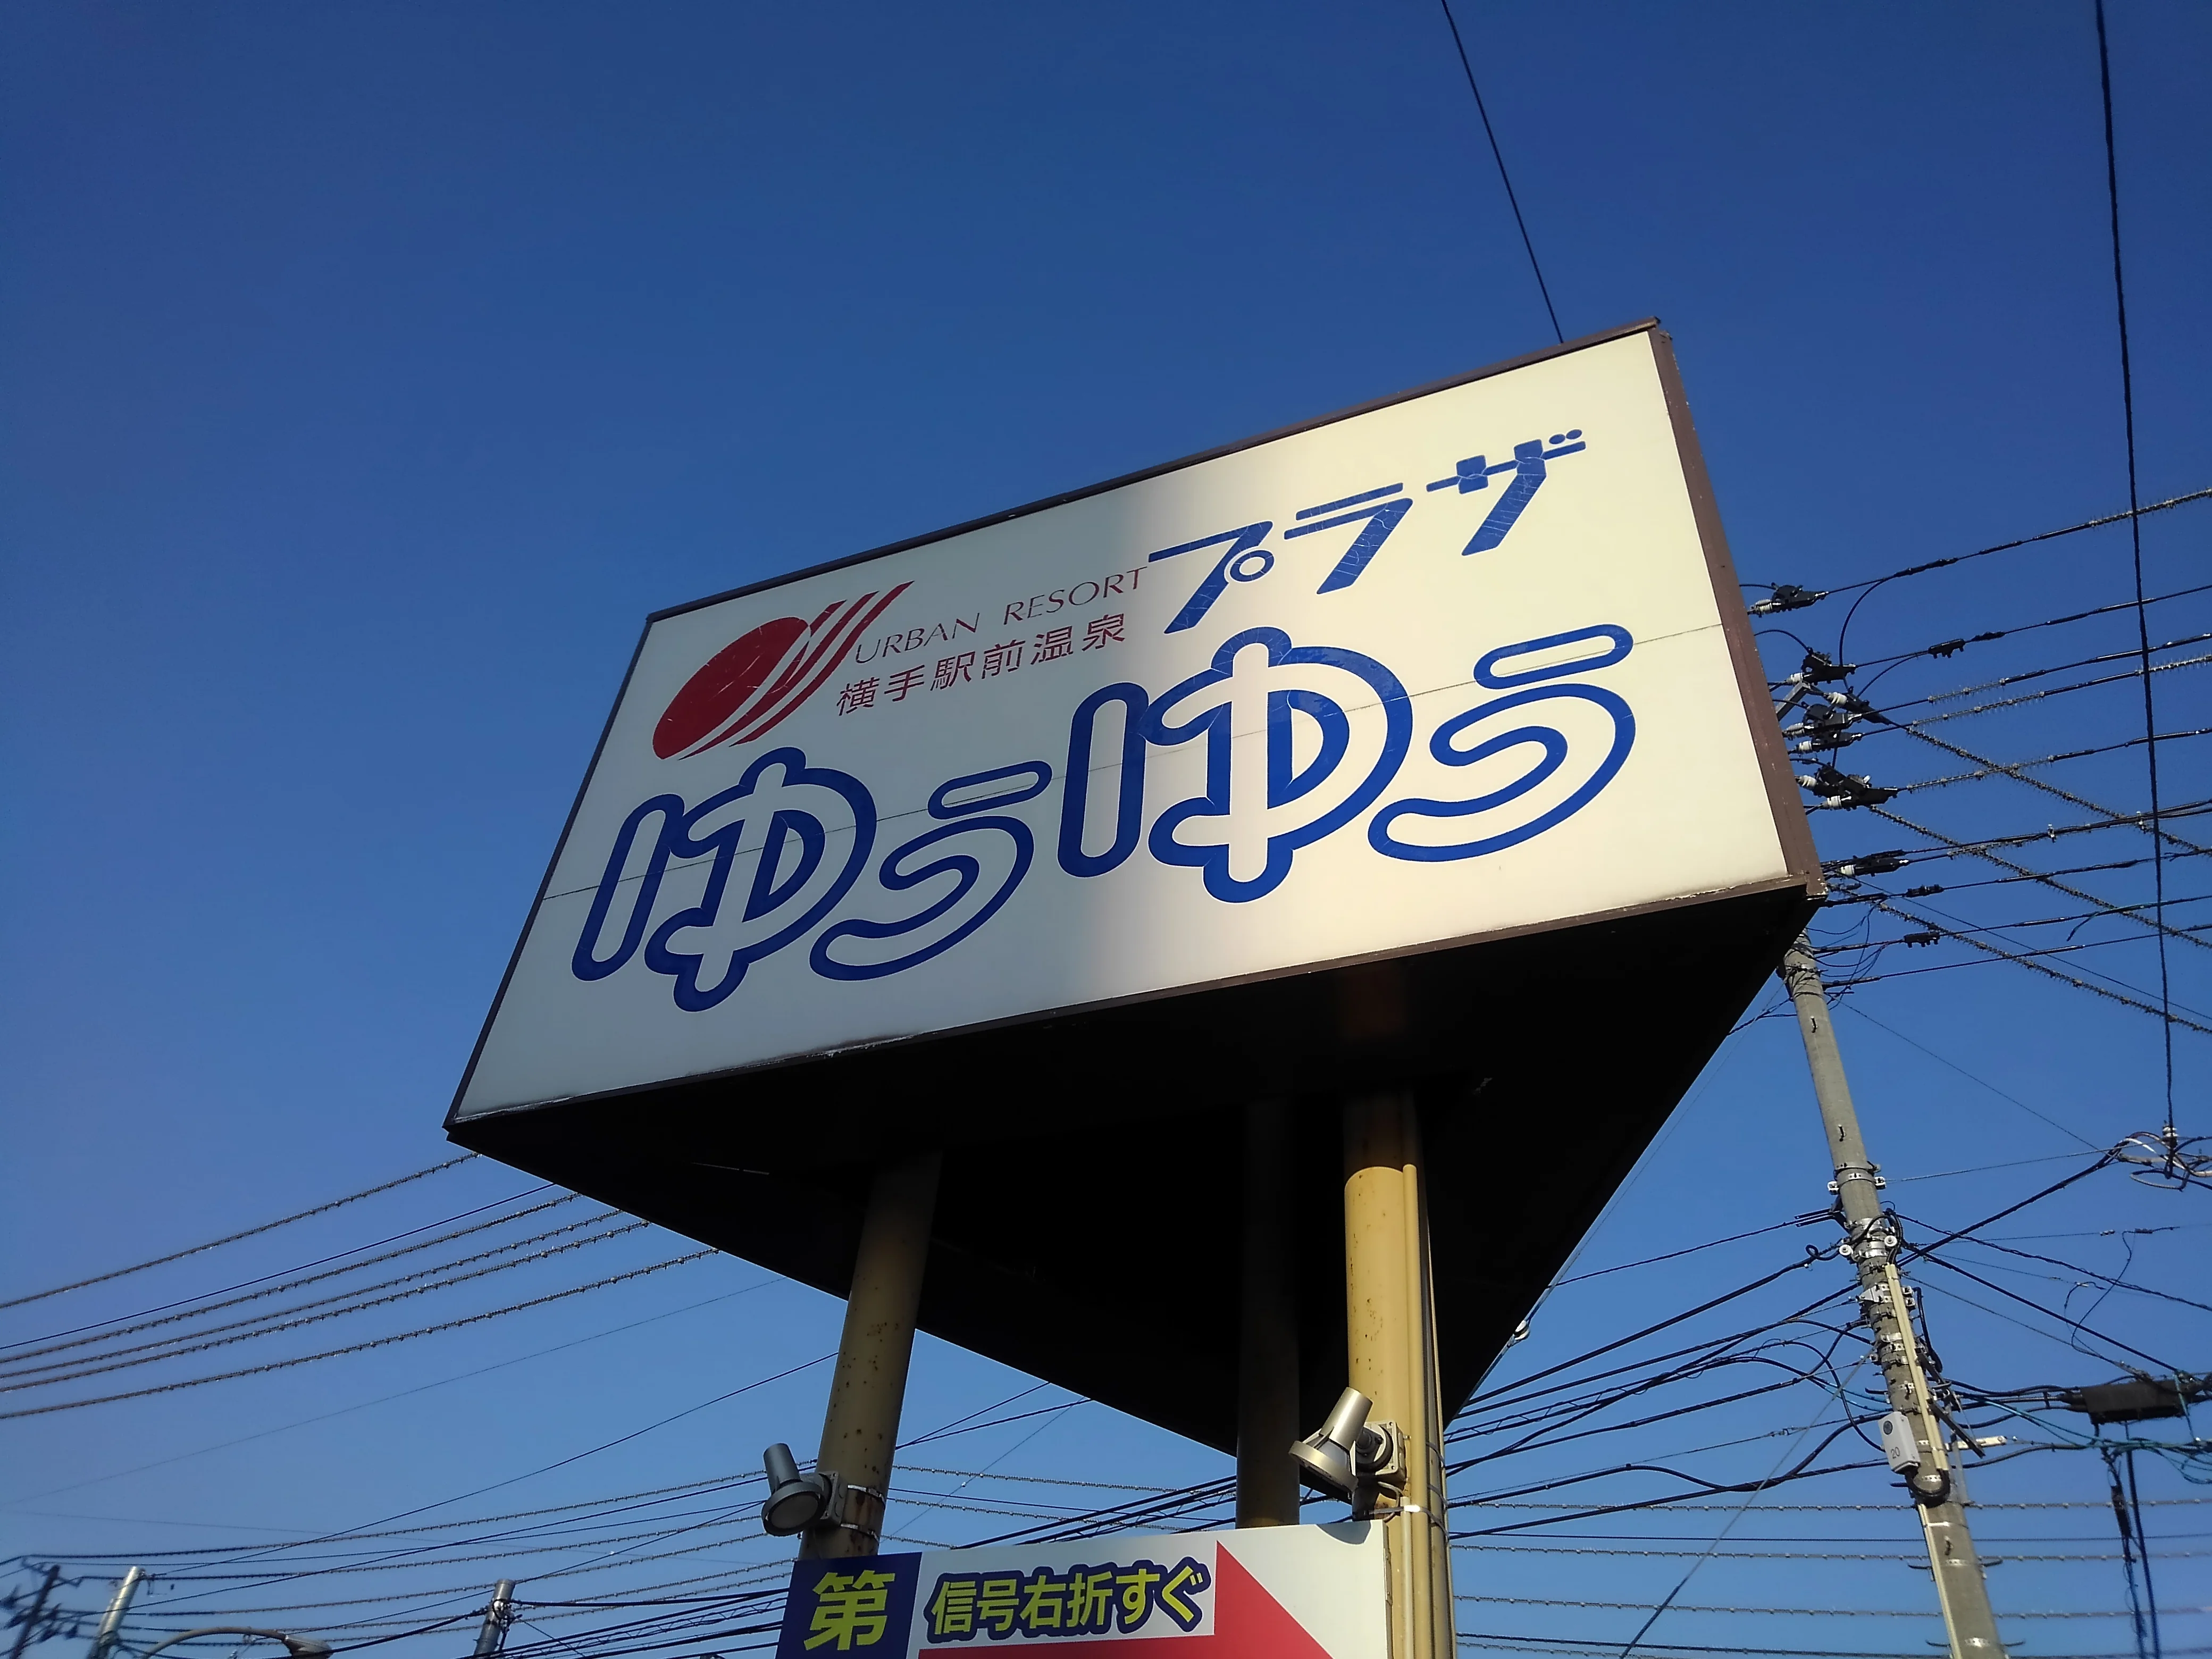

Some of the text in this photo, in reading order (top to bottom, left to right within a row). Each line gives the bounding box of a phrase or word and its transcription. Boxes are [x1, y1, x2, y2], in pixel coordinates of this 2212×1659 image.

[1148, 429, 1586, 634] プラザ
[856, 566, 1149, 664] URBAN RESORT
[836, 613, 1126, 717] 横手駅前温泉
[571, 625, 1636, 1012] ゆうゆう
[1890, 1446, 1900, 1459] 20
[803, 1569, 896, 1651] 第
[929, 1562, 1205, 1637] 信号右折すぐ
